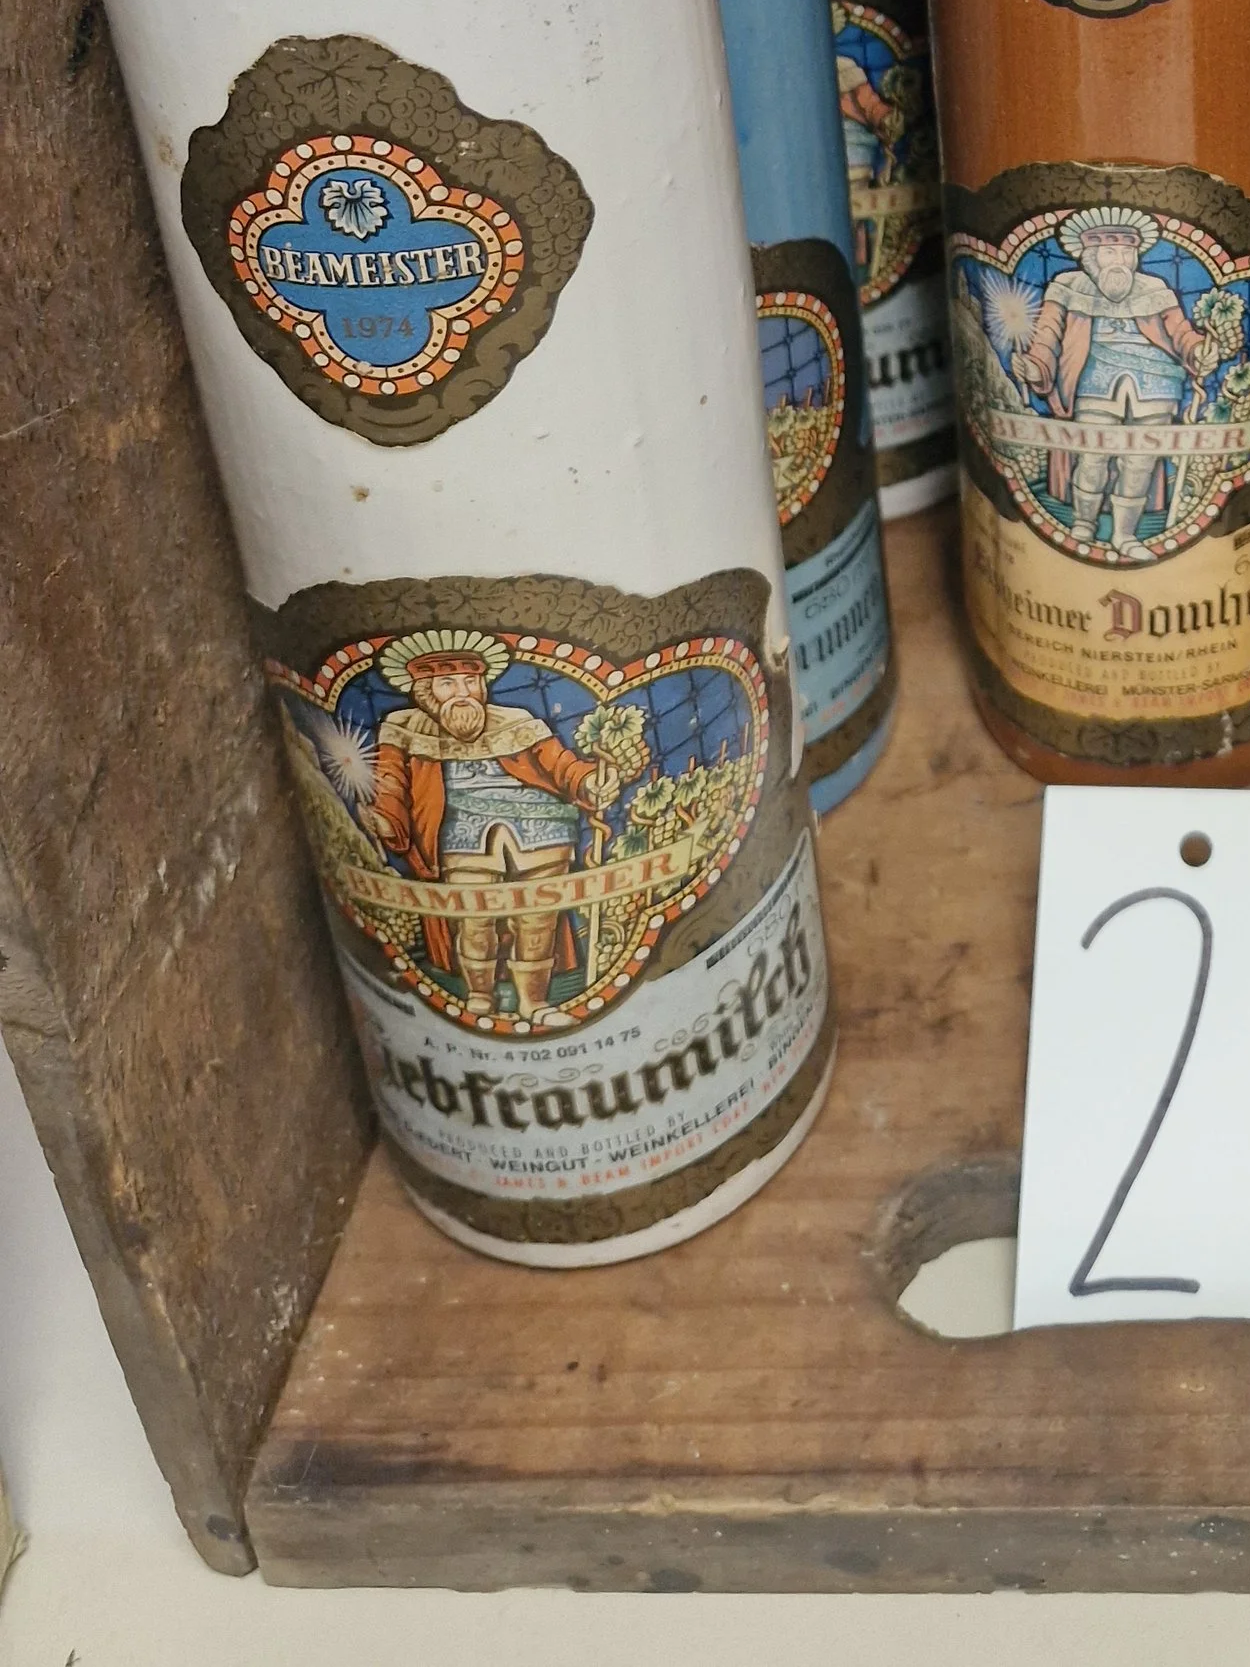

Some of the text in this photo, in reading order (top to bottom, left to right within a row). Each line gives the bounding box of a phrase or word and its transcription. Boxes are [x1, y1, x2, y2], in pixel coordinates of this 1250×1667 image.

[260, 240, 488, 288] BEAMEISTER
[340, 315, 415, 340] 1974
[989, 408, 1247, 452] BEAMEISTER
[1080, 638, 1238, 664] NIERSTEIN/RHEIN
[350, 852, 681, 913] BEAMEISTER
[382, 900, 811, 1133] iebfraumilch
[521, 1048, 553, 1062] 702
[595, 1035, 615, 1051] 14
[621, 1025, 642, 1044] 75
[490, 1156, 589, 1174] WEINGUT
[610, 1076, 756, 1164] WEINKELLEREI
